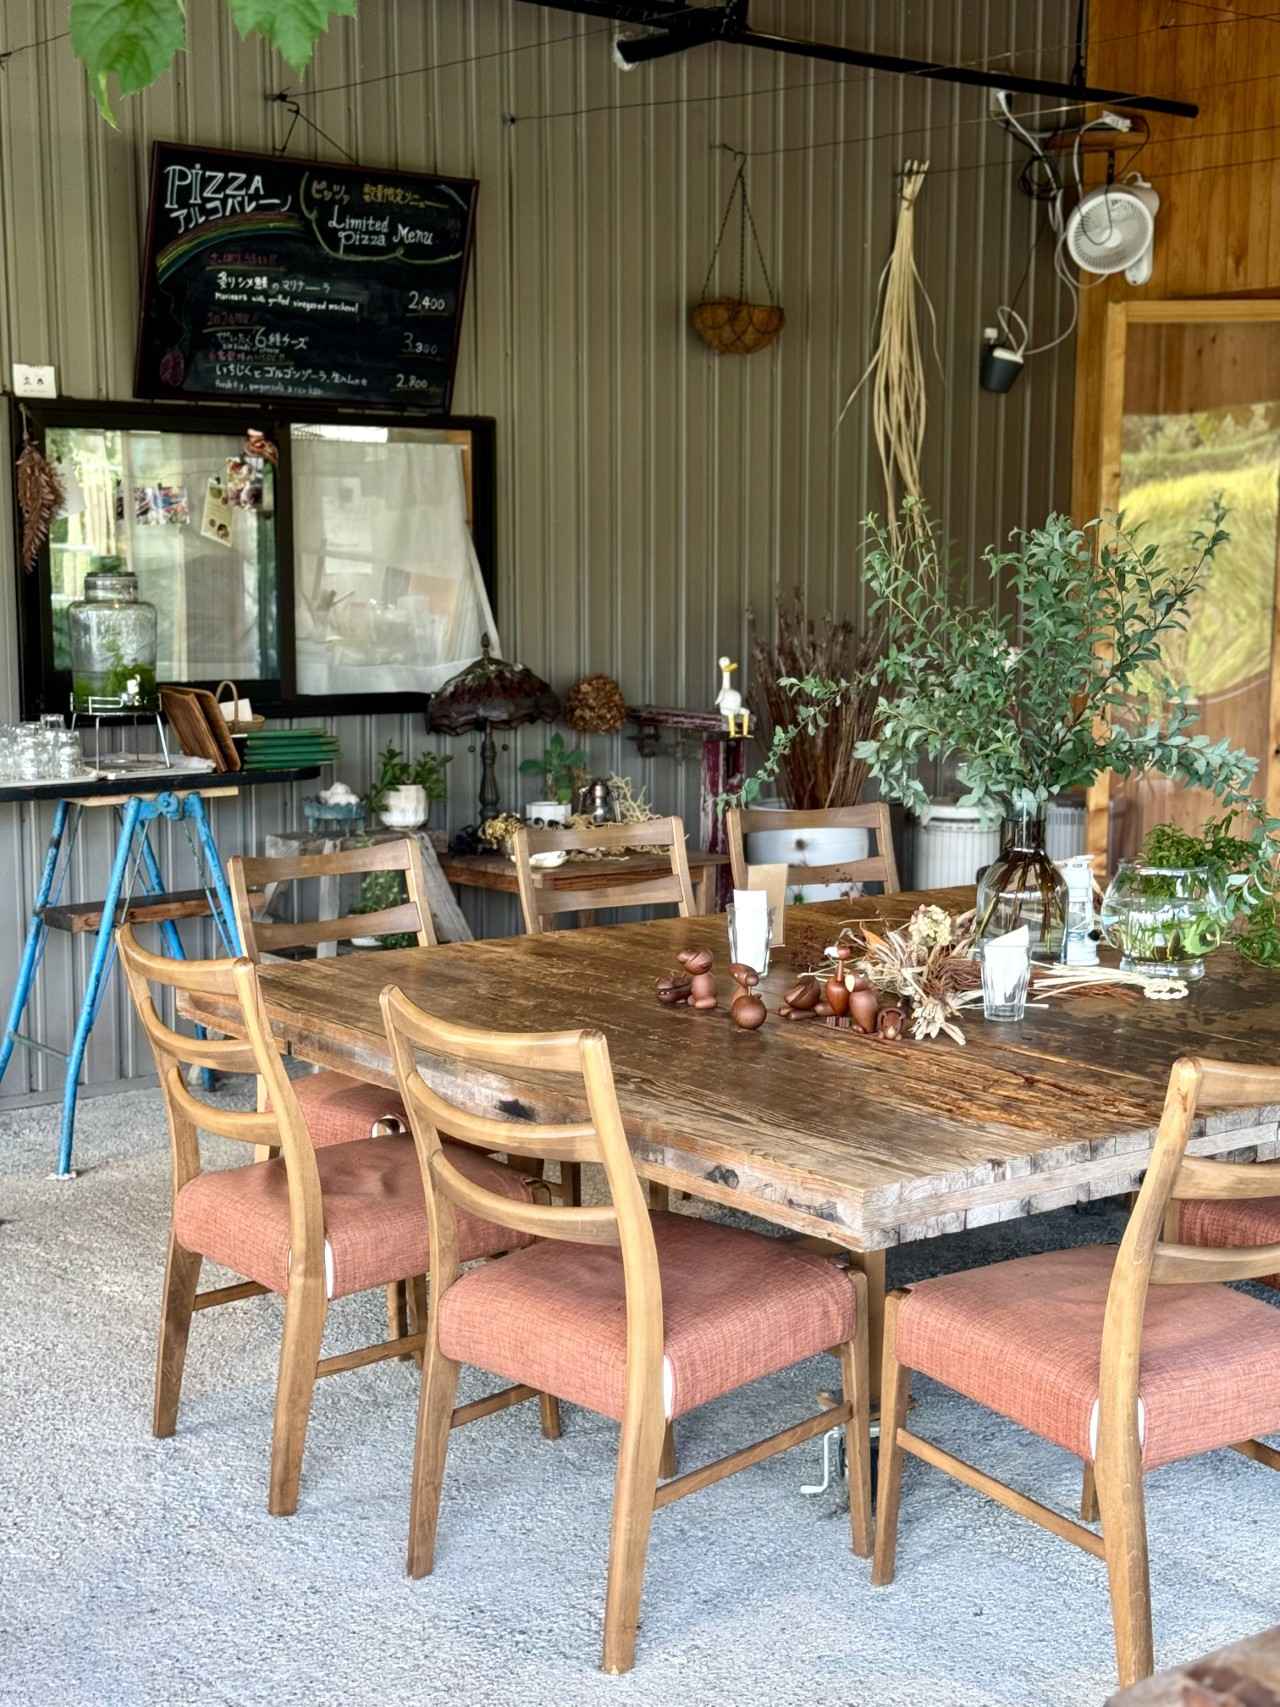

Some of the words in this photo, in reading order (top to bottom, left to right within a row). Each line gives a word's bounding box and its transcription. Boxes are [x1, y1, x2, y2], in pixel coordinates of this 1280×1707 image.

[327, 204, 389, 234] Limited
[392, 223, 433, 246] Menu
[407, 289, 446, 312] 2,400
